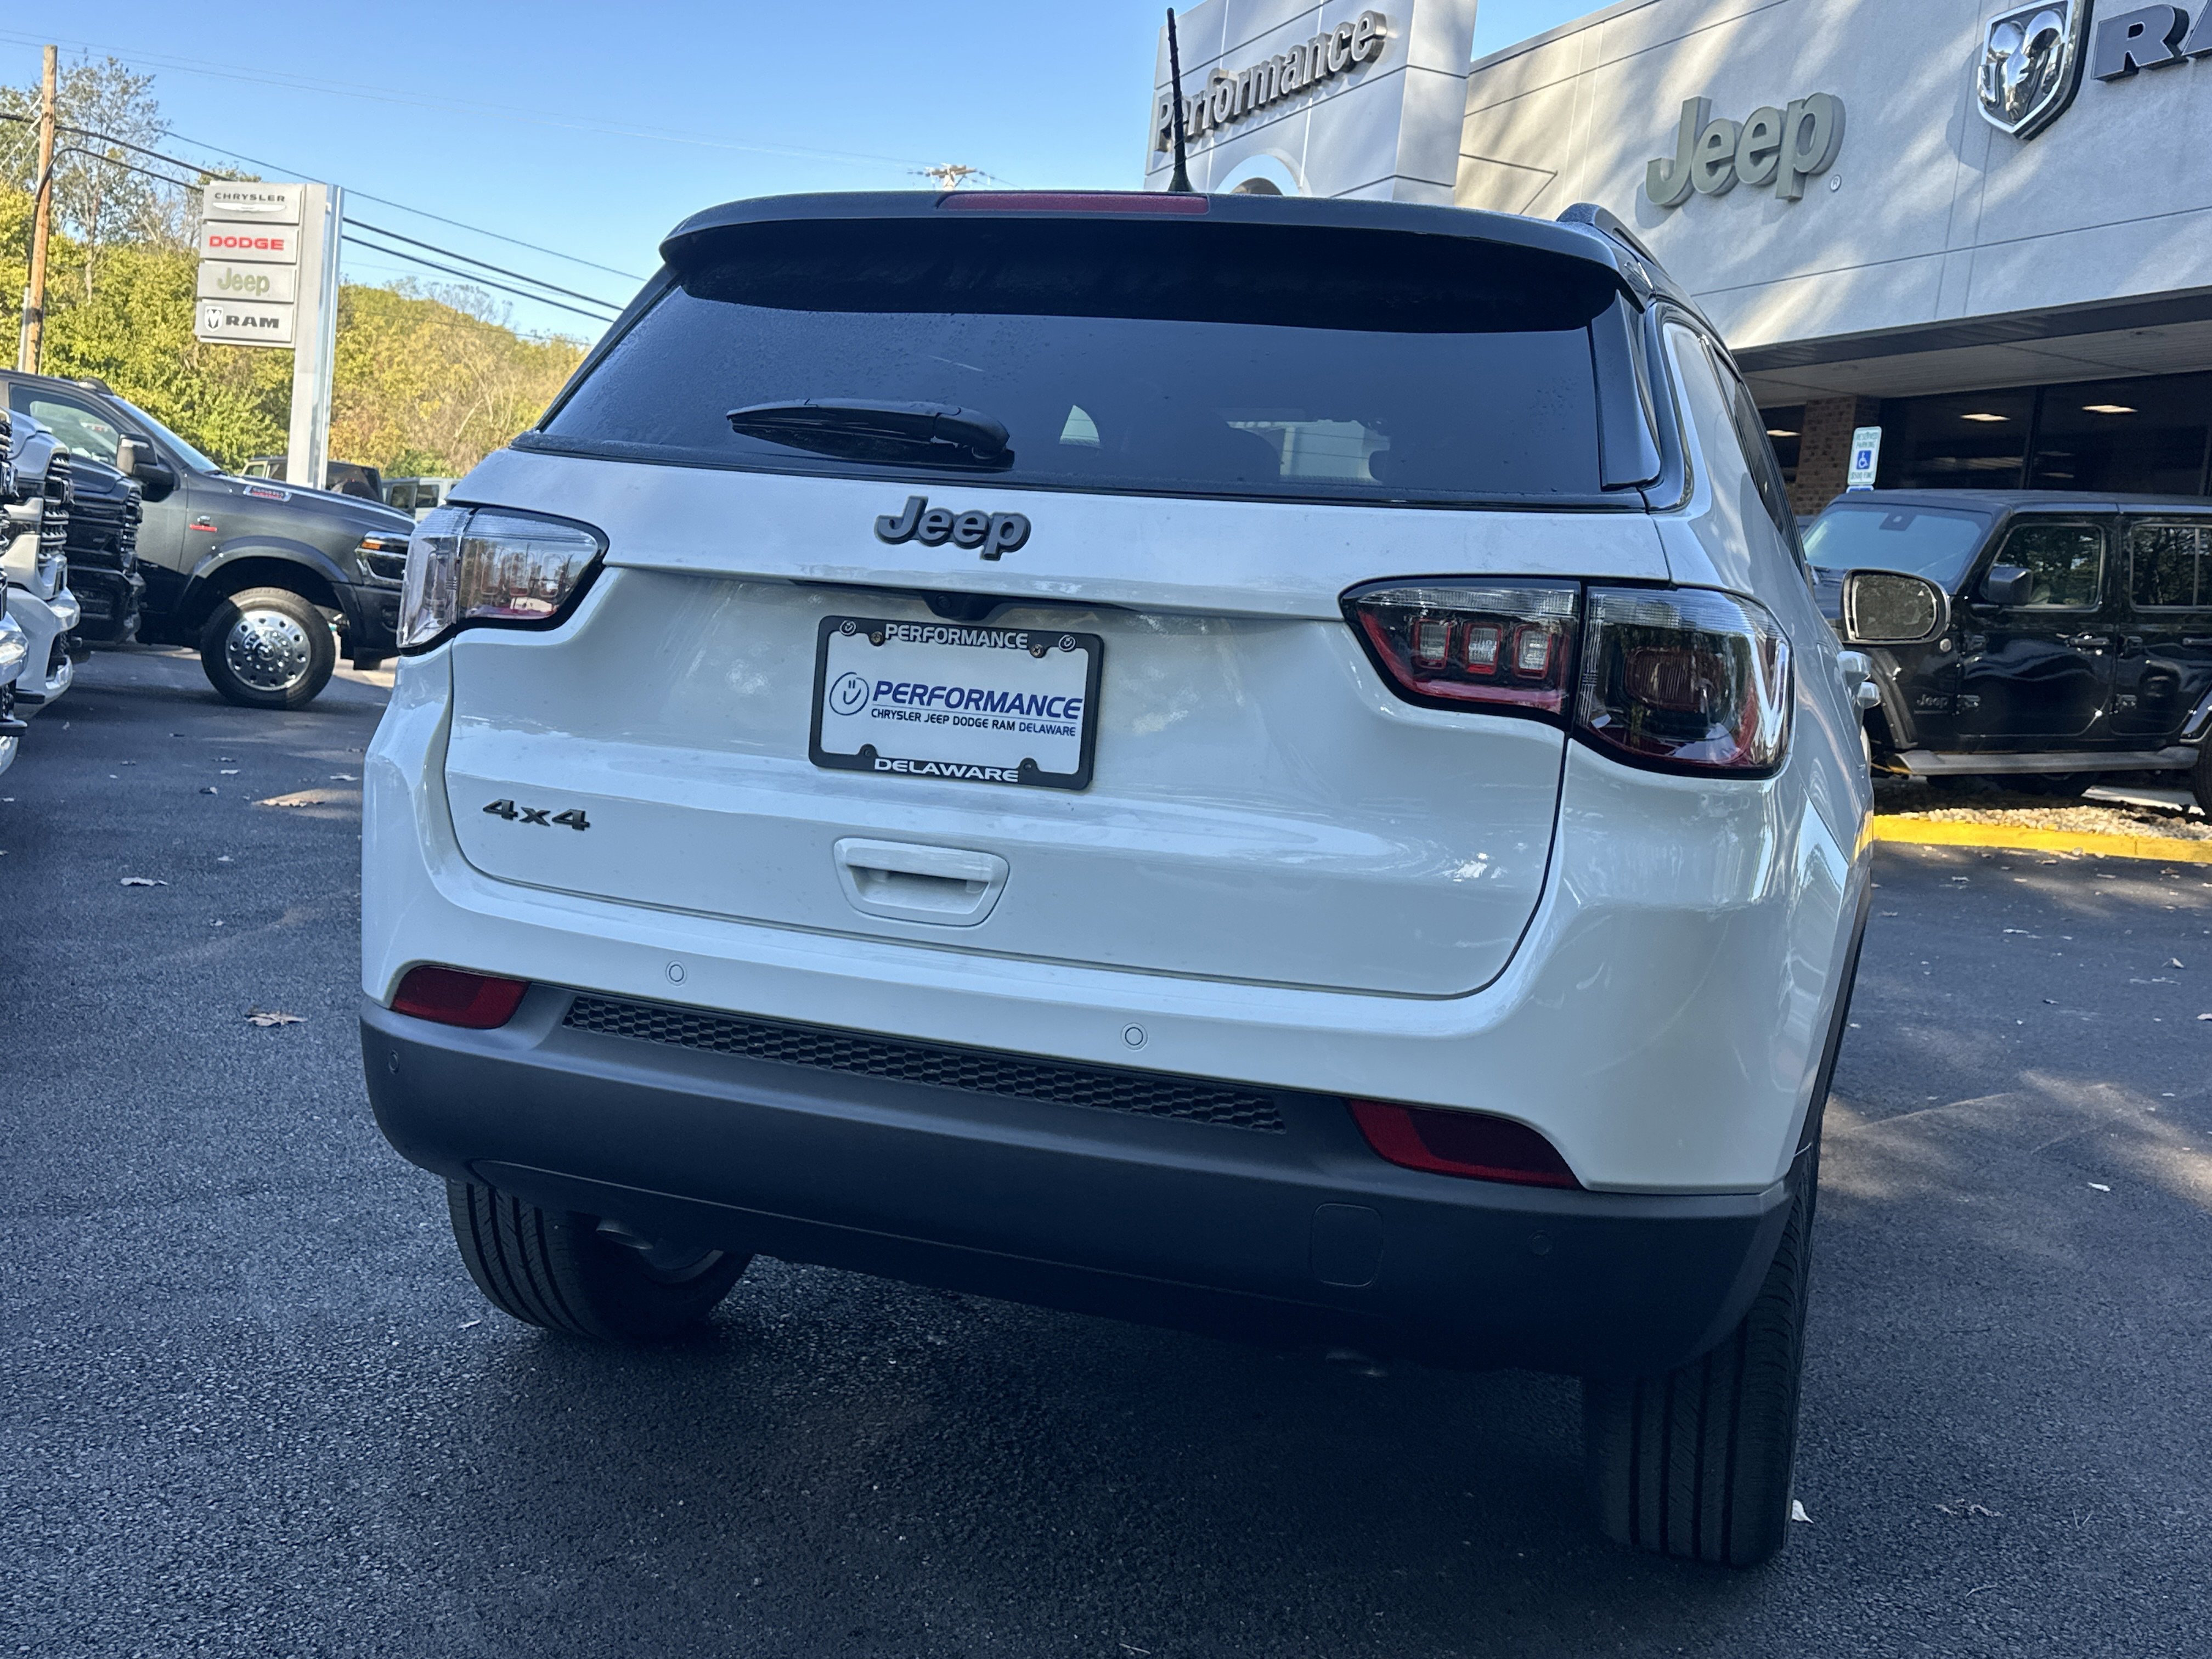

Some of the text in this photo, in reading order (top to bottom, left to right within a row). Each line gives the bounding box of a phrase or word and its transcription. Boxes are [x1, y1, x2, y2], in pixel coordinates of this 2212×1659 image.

[1646, 92, 1846, 205] Jeep
[215, 193, 285, 202] CHRYSLER
[209, 236, 284, 251] DODGE
[217, 267, 270, 296] Jeep
[226, 315, 279, 329] RAM
[874, 495, 1031, 561] Jeep
[885, 624, 1029, 649] PERFORMANCE
[873, 680, 1083, 719] PERFORMANCE
[871, 708, 1076, 737] CHRYSLER JEEP DODGE RAM DELAWARE
[874, 758, 1019, 782] DELAWARE
[483, 799, 590, 831] 4x4
